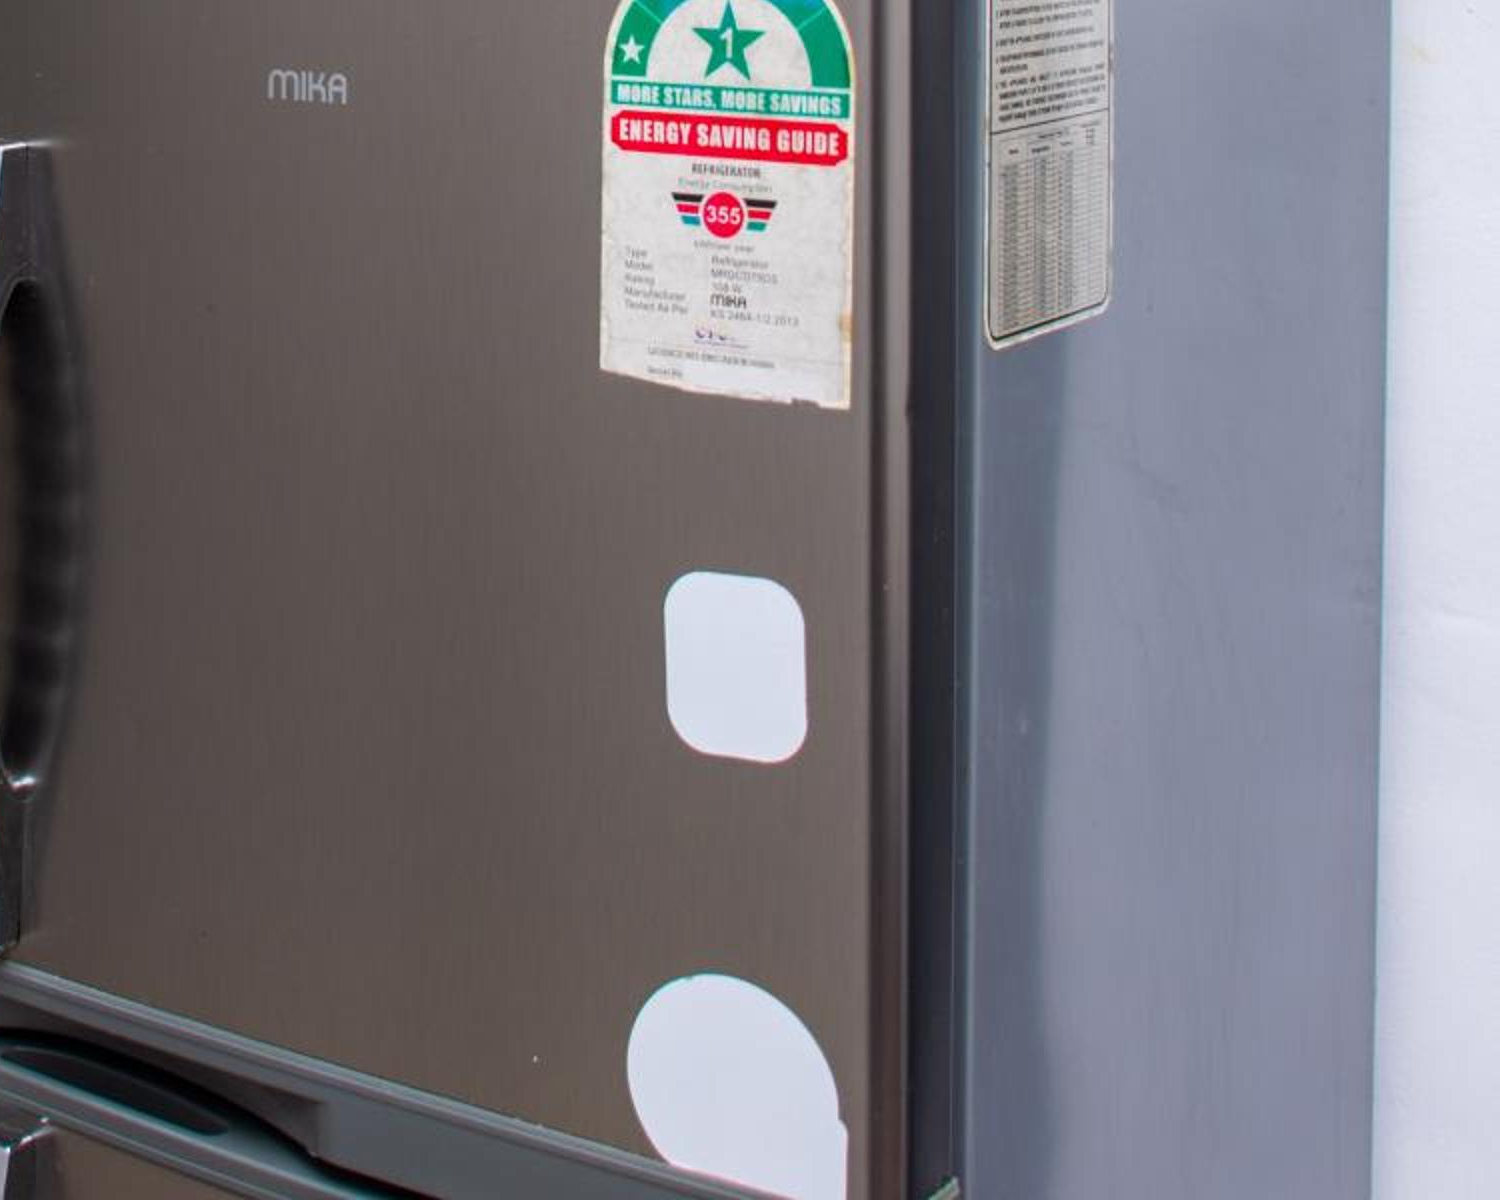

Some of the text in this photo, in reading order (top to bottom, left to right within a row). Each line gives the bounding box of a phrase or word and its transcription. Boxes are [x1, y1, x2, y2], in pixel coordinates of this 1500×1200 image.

[719, 28, 734, 60] 1
[267, 68, 349, 106] MIKA
[617, 83, 661, 105] MORE
[721, 89, 766, 113] MORE
[769, 92, 842, 117] SAVINGS
[619, 118, 840, 156] ENERGY SAVING GUIDE
[691, 163, 762, 179] REFRIGERATOR
[706, 204, 741, 226] 355
